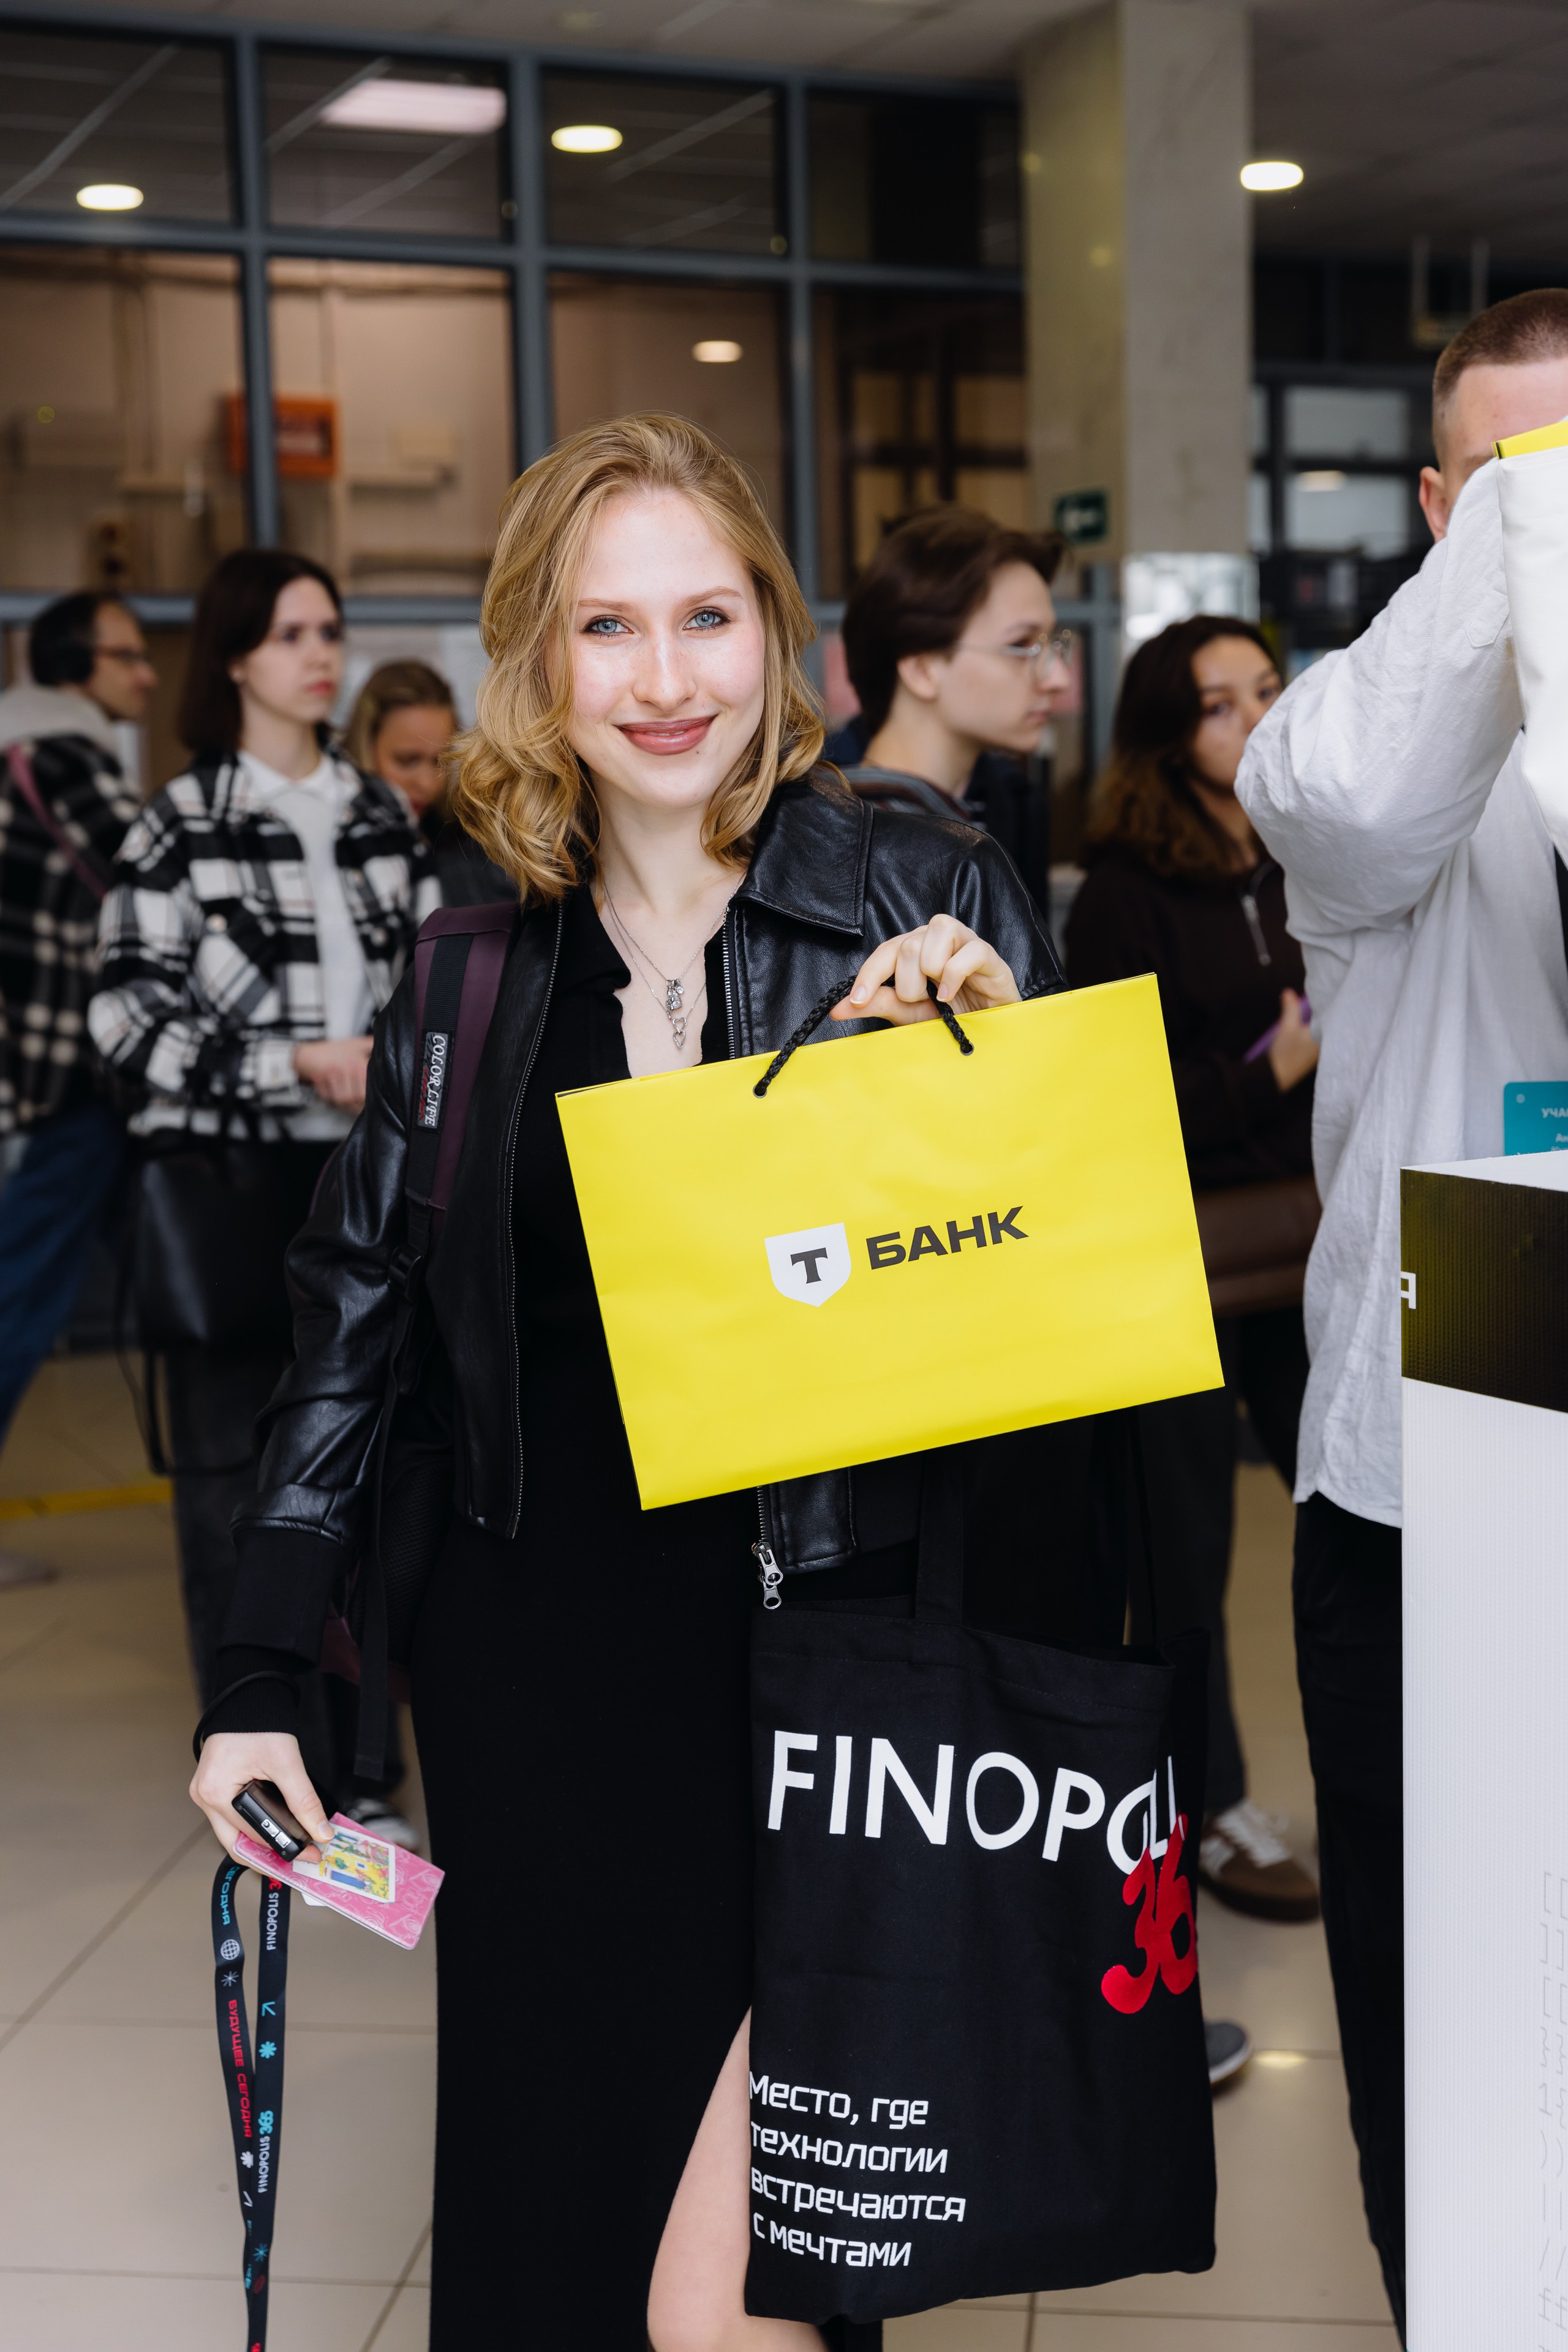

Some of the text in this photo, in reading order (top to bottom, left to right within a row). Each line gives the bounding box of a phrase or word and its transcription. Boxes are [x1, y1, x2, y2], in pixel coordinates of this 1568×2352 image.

[424, 1035, 446, 1126] COLORLIFE
[1541, 1107, 1568, 1118] УЧА
[865, 1205, 1029, 1270] БАНК
[767, 1730, 1185, 1875] FINOPOLI
[266, 1892, 279, 1951] FINOPOLIS
[228, 1999, 252, 2138] БУДУЩЕЕ СЕГОДНЯ
[749, 2071, 929, 2130] Место, где
[751, 2121, 948, 2173] технологии
[751, 2167, 966, 2222] встречаются
[753, 2212, 911, 2267] с мечтами
